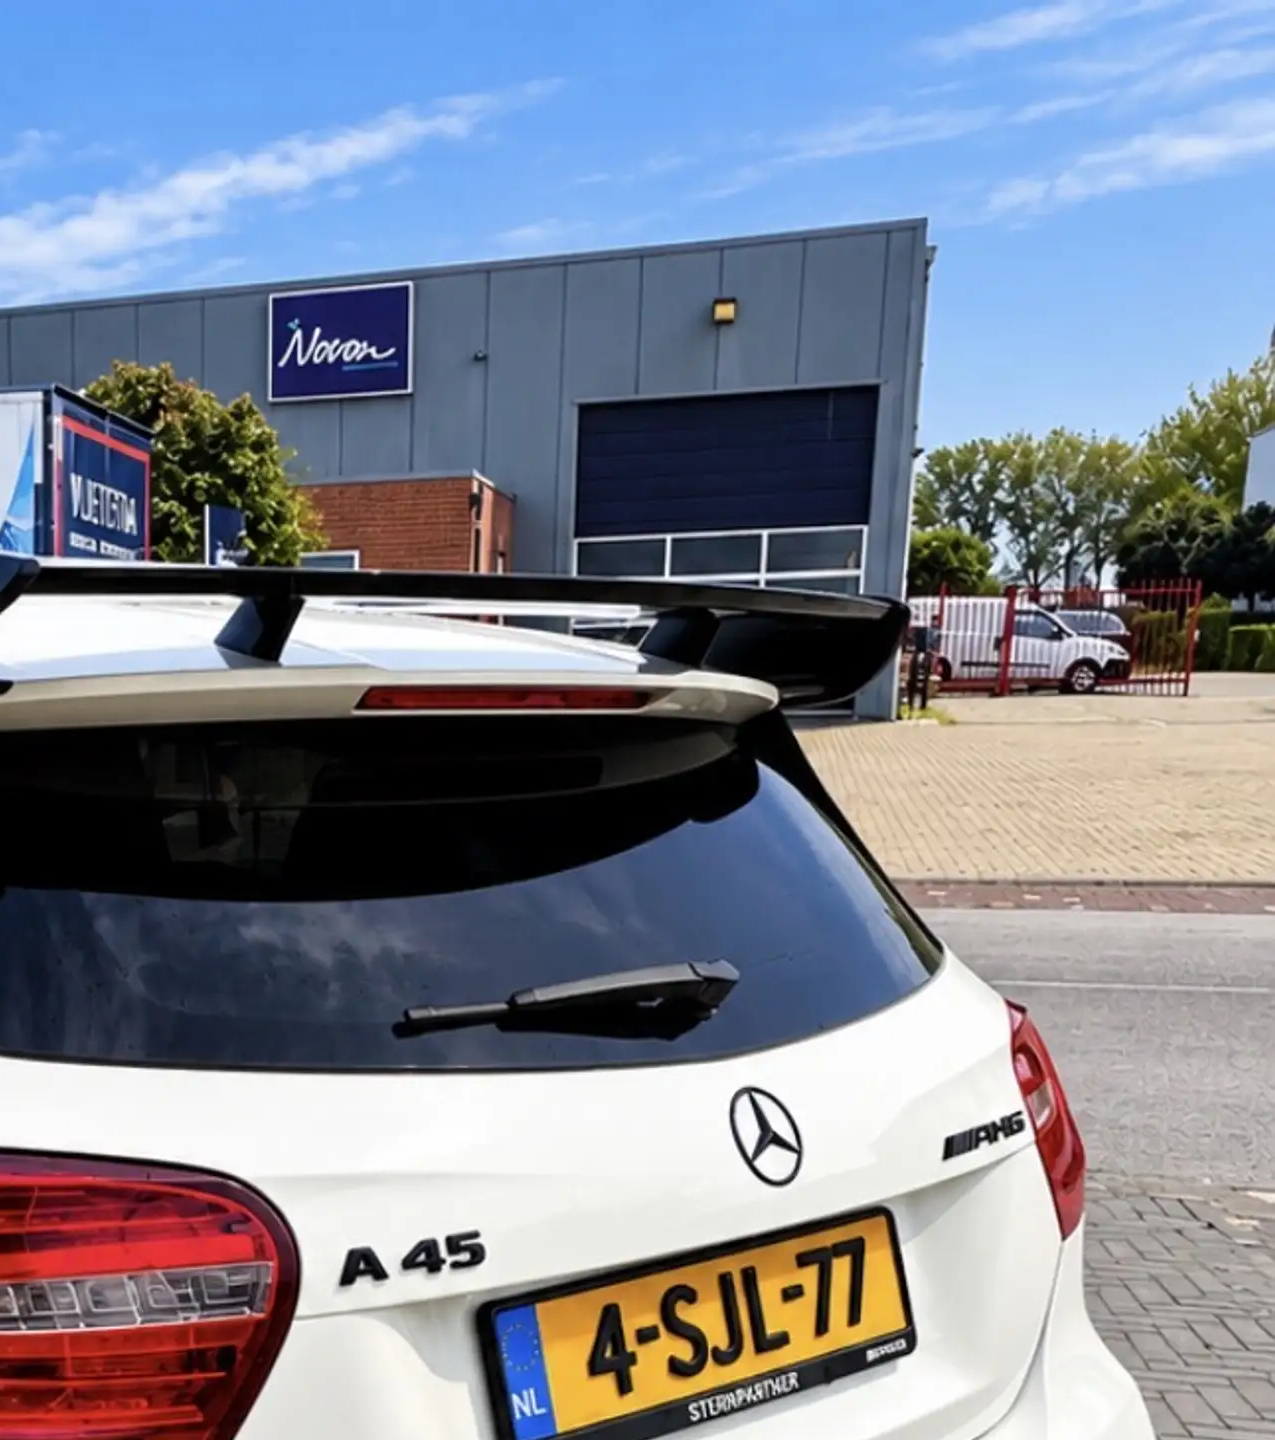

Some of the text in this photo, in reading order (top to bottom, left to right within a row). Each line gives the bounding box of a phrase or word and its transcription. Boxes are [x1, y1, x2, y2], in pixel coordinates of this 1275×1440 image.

[277, 326, 397, 368] Novon
[339, 1229, 486, 1287] A 45
[587, 1237, 866, 1398] 4-SJL-77
[511, 1388, 548, 1422] NL
